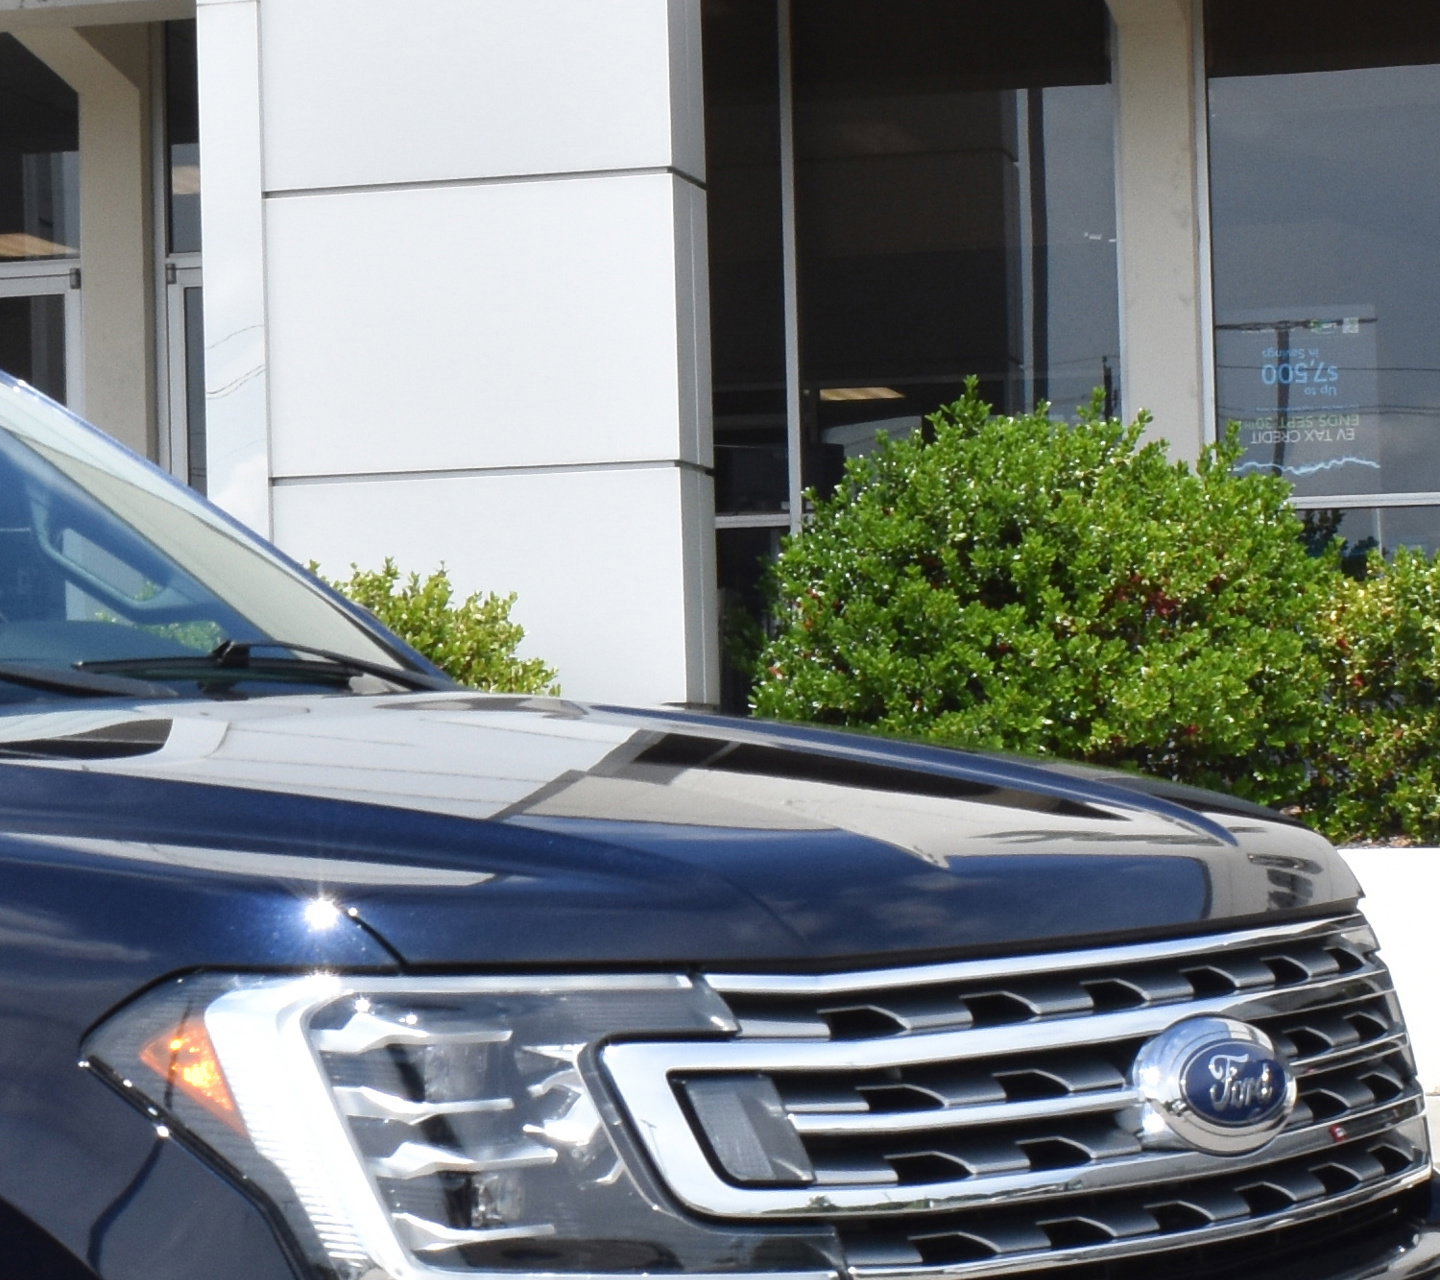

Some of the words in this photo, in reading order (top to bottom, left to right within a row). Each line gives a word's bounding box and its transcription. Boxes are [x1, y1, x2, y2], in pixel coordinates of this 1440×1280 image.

[1261, 346, 1306, 359] Savings
[1261, 359, 1339, 385] $7,500
[1304, 387, 1317, 396] to
[1320, 384, 1337, 396] Up
[1319, 414, 1360, 428] ENDS
[1250, 430, 1301, 444] CREDIT
[1304, 429, 1332, 442] TAX
[1336, 427, 1355, 441] EV
[1207, 1053, 1273, 1111] Ford
